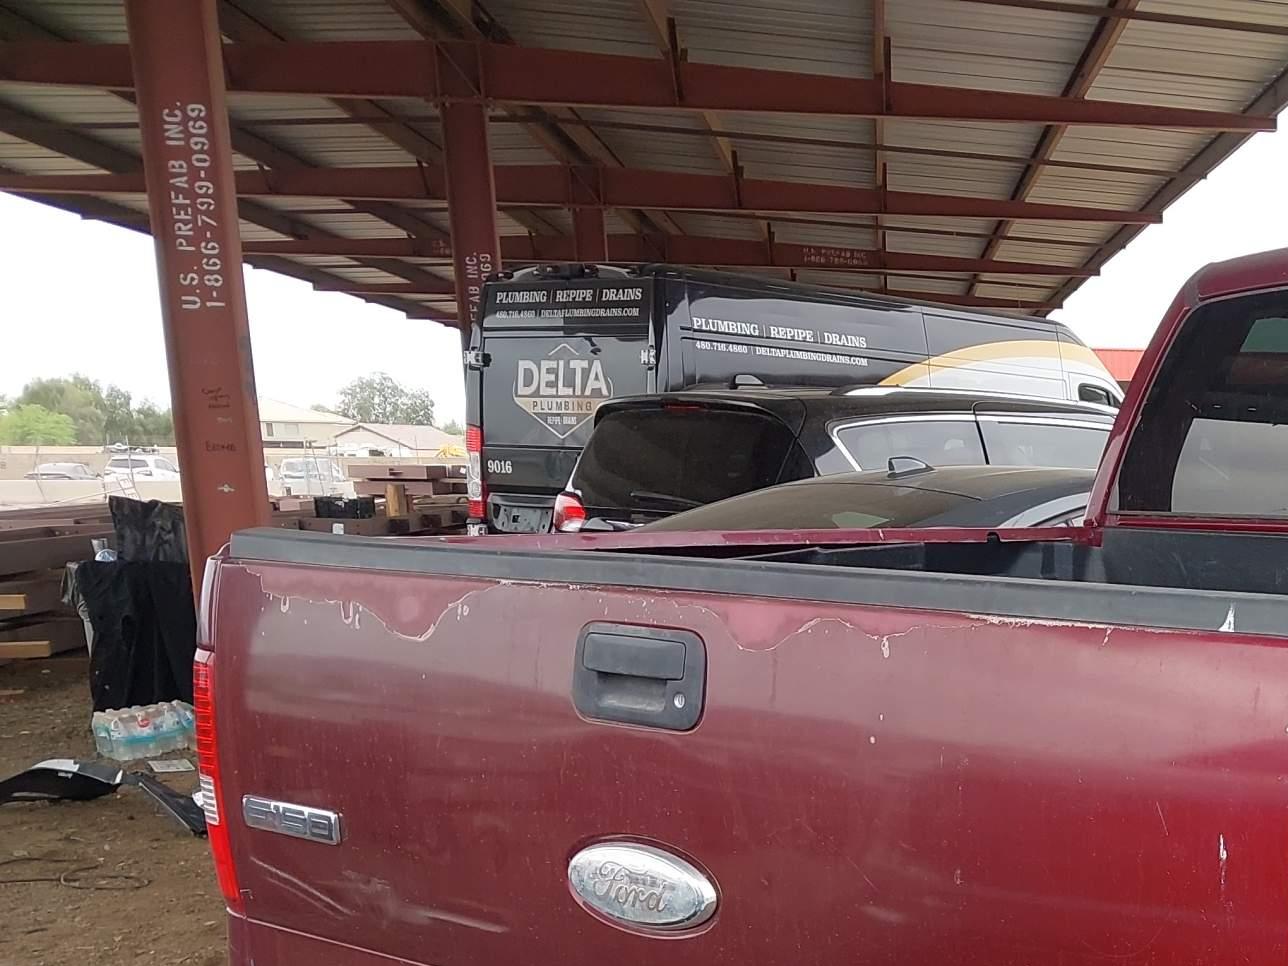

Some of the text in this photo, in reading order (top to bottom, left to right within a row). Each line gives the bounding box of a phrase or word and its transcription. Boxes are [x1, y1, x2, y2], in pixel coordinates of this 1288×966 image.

[162, 101, 201, 309] U.S. PREFAB INC.
[186, 103, 226, 307] 1-866-799-0969
[465, 252, 479, 279] INC.
[496, 288, 642, 304] PLUMBING REPIPE DRAINS
[692, 317, 867, 348] PLUMBING REPIPE DRAINS
[696, 341, 868, 367] 480.716.4860 DELTAPLUMBINGDRAINS.COM
[517, 359, 609, 396] DELTA
[532, 400, 592, 411] PLUMBING
[487, 460, 513, 474] 9016
[590, 861, 667, 913] Ford
